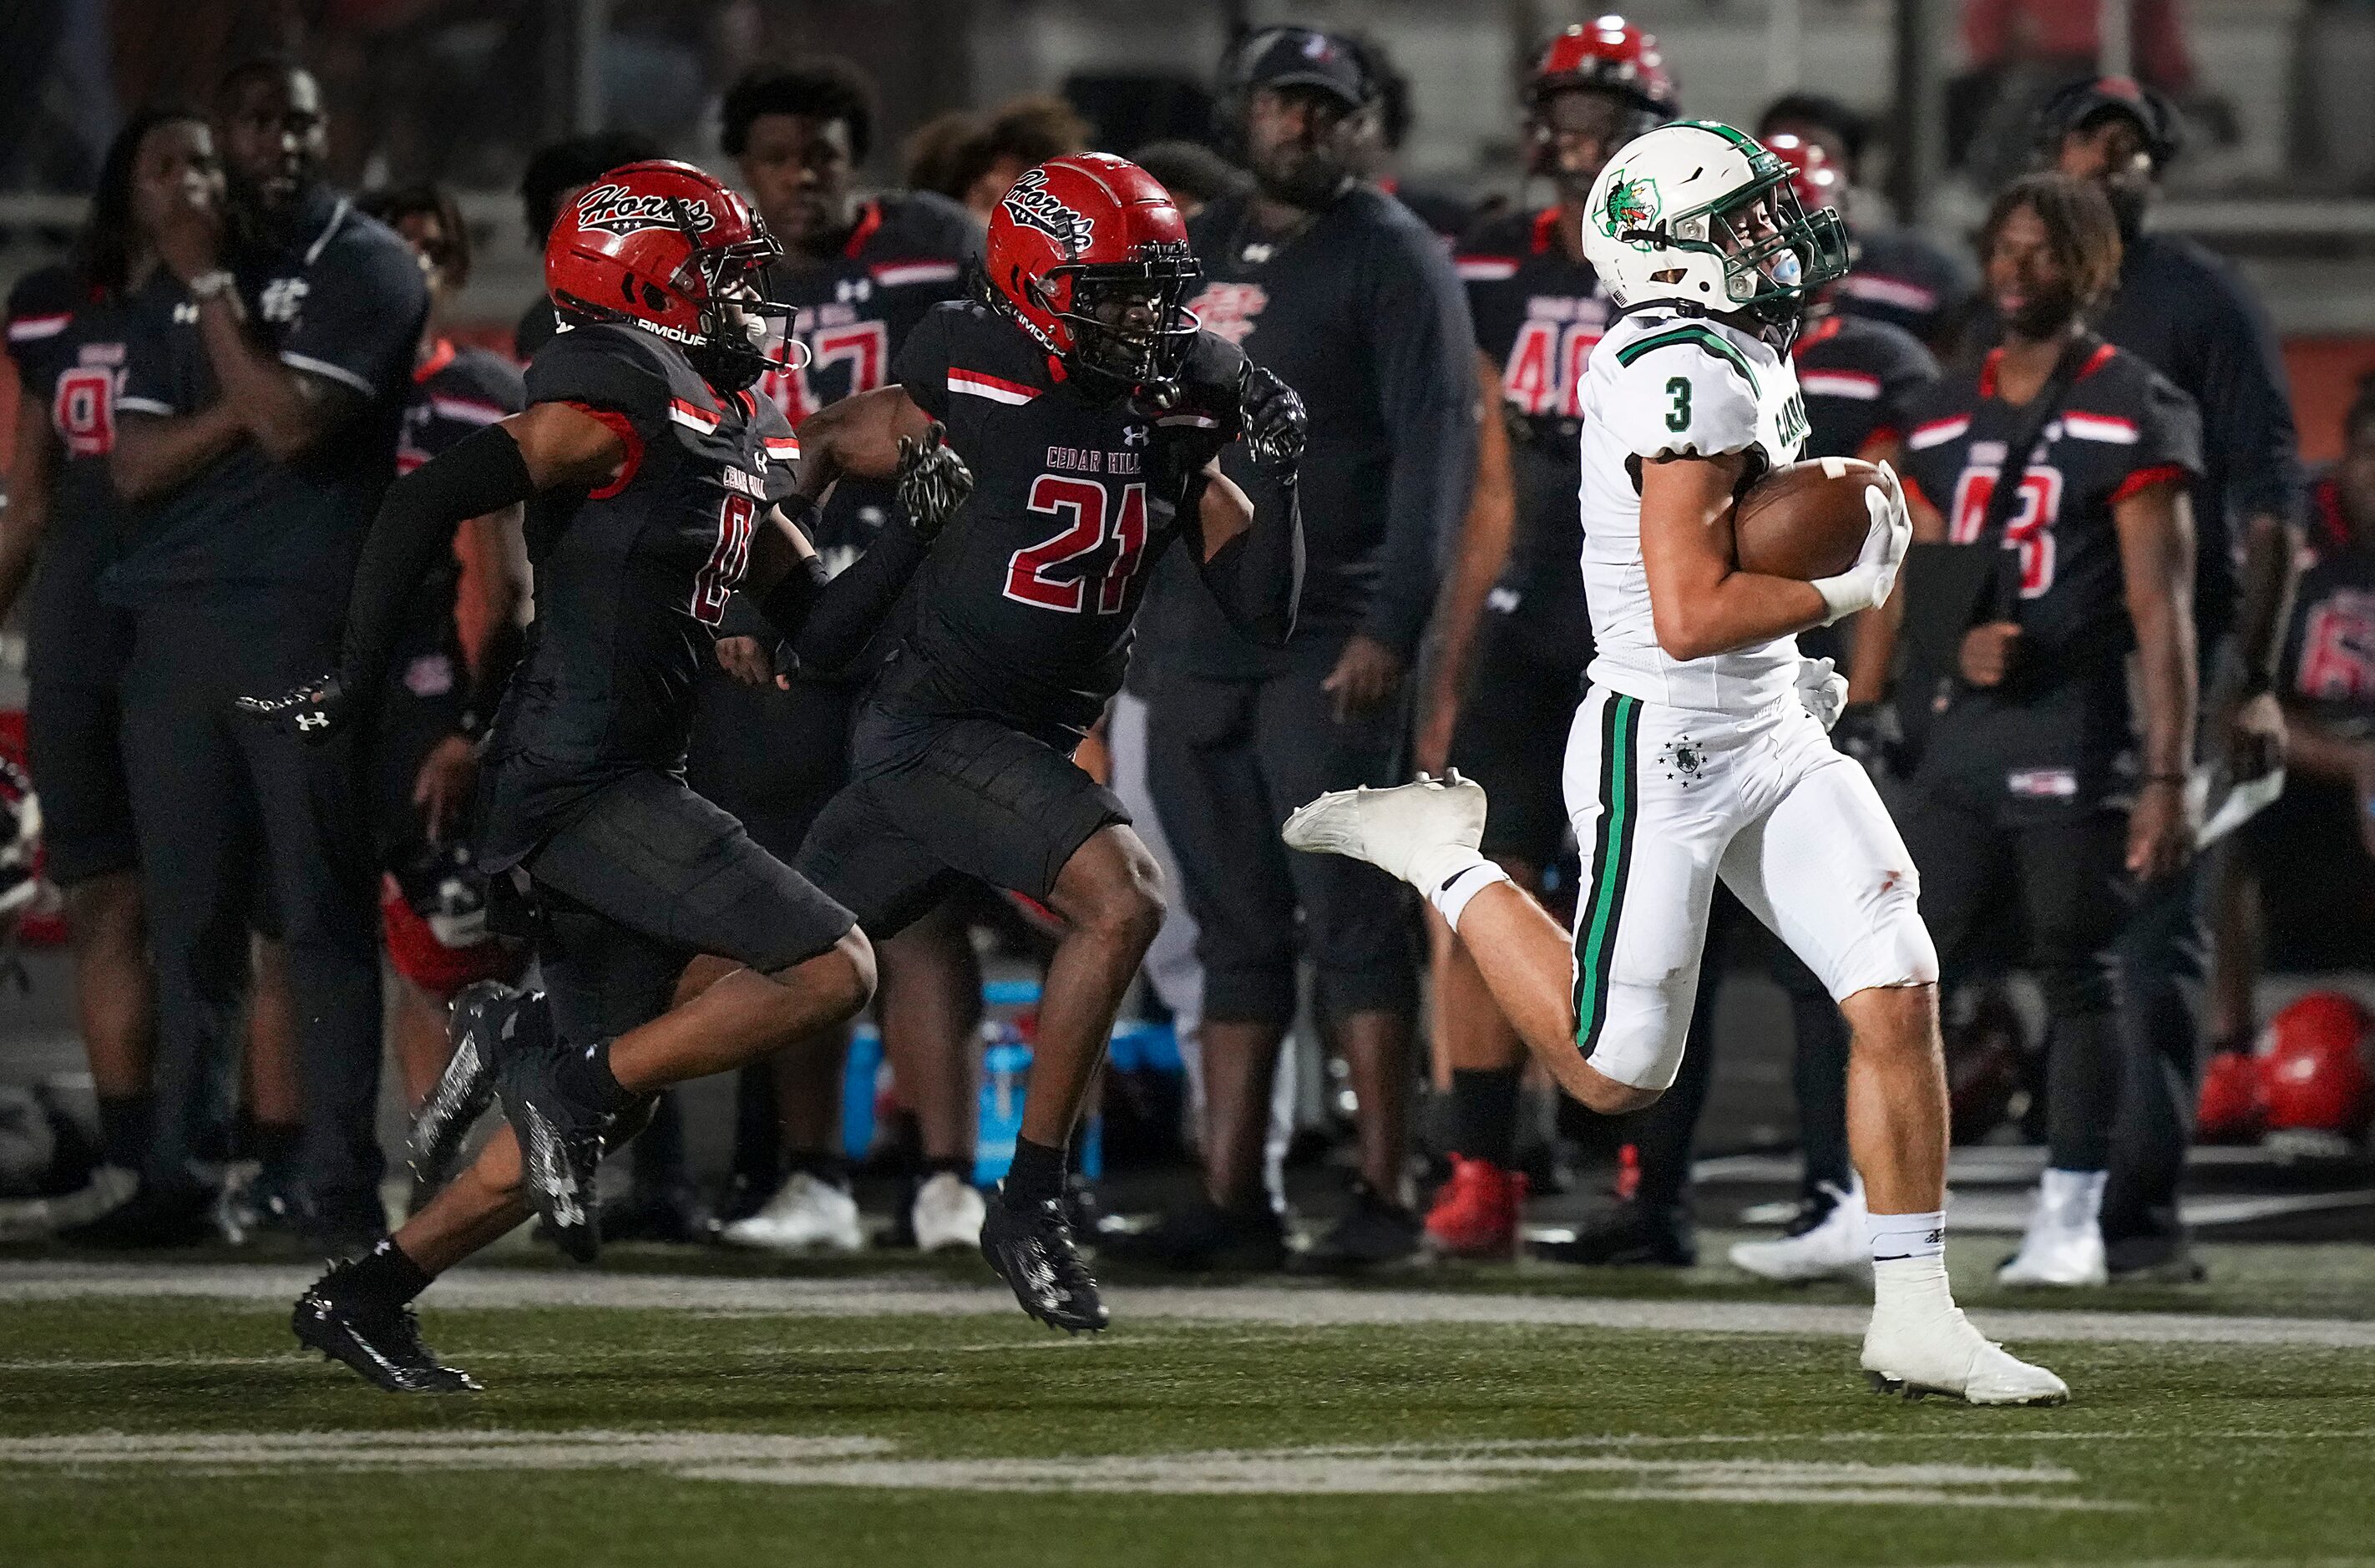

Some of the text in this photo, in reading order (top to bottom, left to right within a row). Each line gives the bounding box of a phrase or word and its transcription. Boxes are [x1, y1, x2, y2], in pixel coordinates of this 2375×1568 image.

[1665, 377, 1692, 432] 3
[1046, 446, 1142, 474] CEDAR HILL
[690, 490, 756, 627] 0
[1002, 473, 1148, 615] 21
